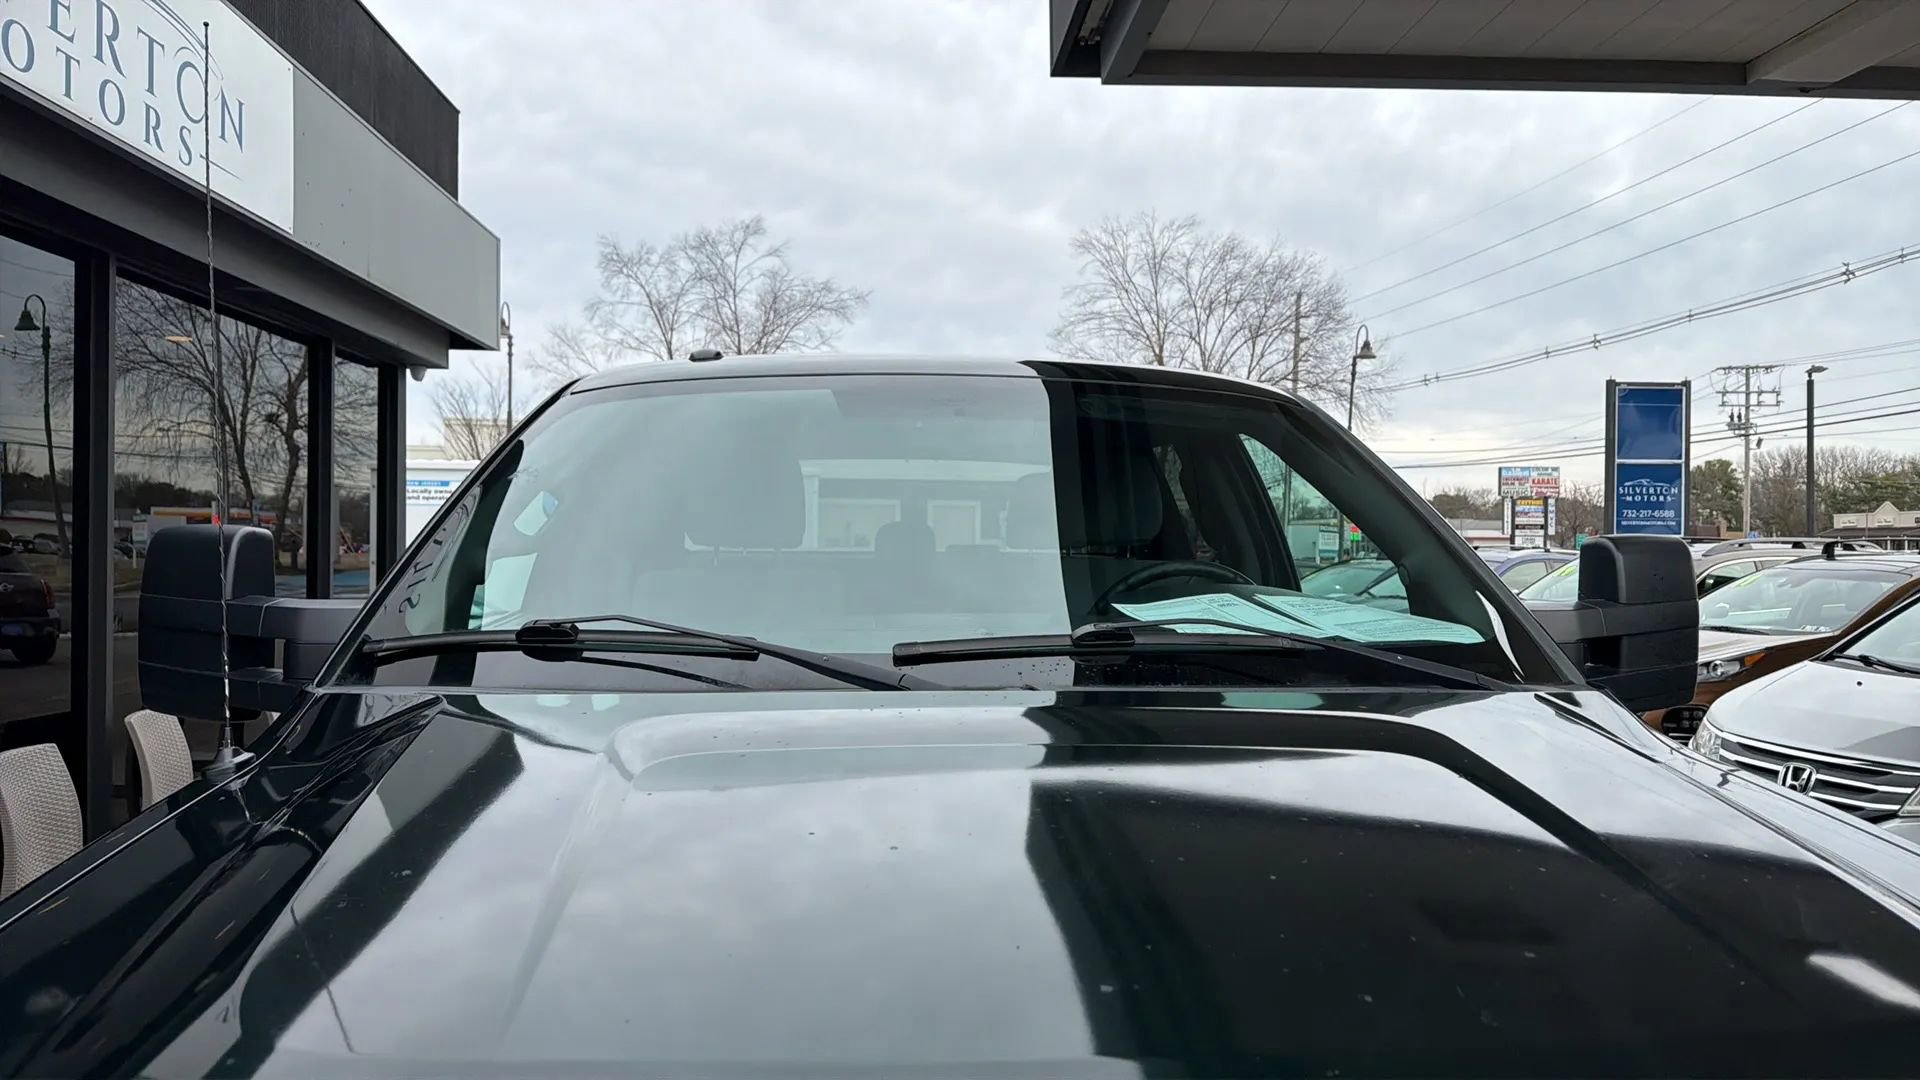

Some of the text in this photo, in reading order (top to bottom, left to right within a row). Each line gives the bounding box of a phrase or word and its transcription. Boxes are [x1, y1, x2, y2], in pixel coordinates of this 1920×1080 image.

[5, 0, 246, 153] ERTON
[1618, 486, 1678, 495] SILVERTON
[1622, 509, 1675, 518] 732-217-6588
